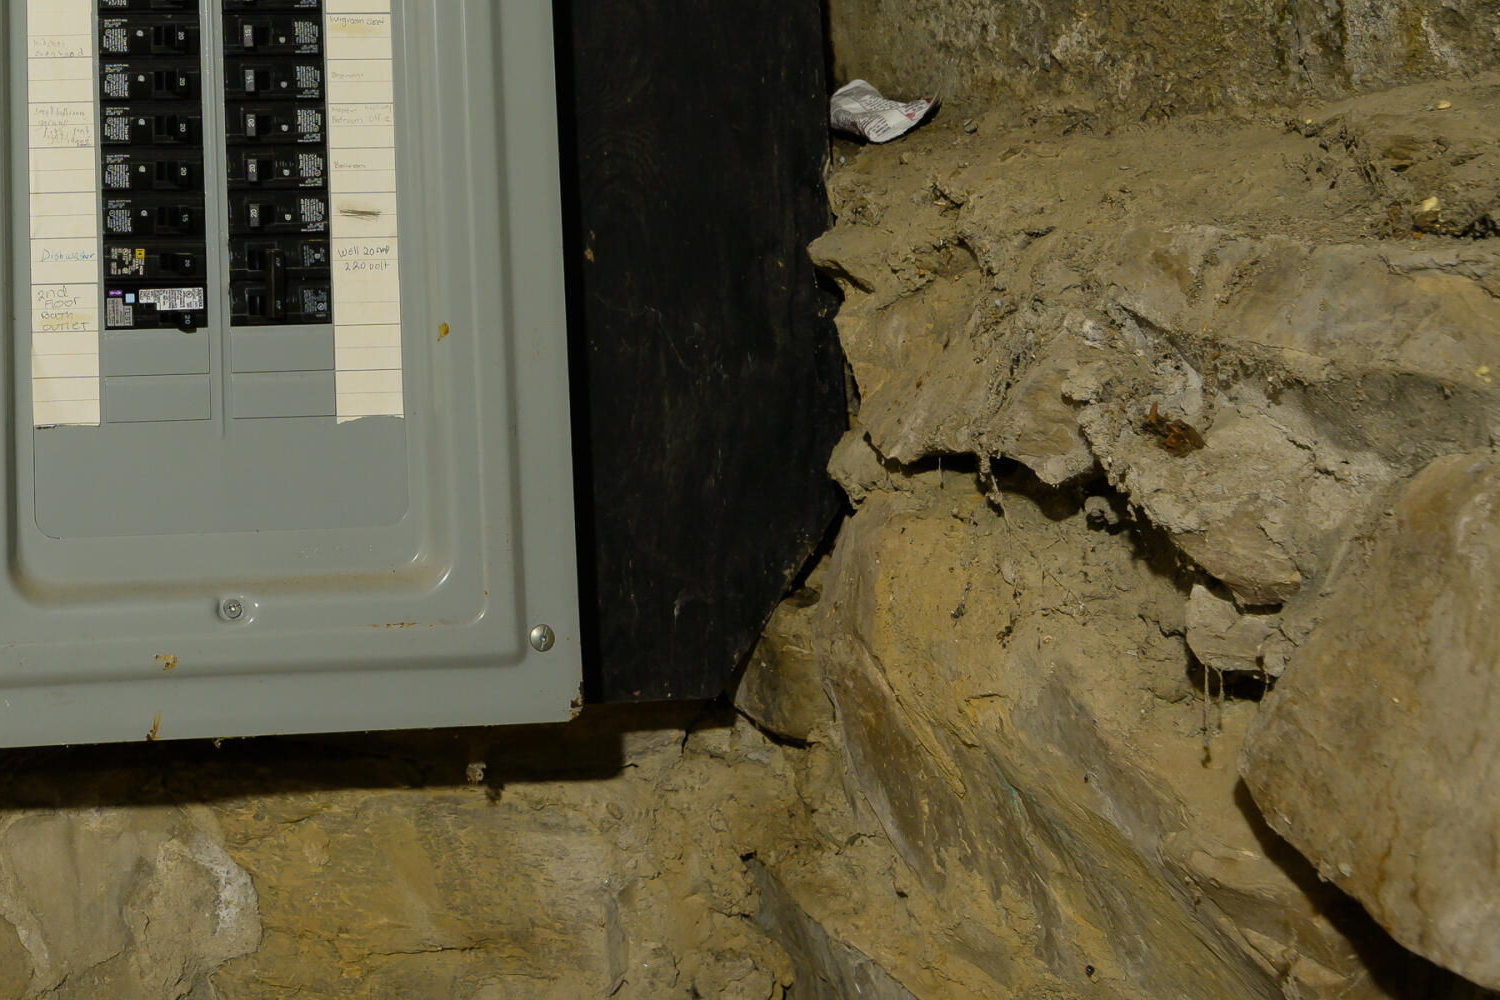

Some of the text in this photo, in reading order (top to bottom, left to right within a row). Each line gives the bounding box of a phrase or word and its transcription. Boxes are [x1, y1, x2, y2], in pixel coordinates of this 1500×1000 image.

[245, 29, 251, 37] 15
[180, 123, 186, 132] 20
[247, 119, 254, 127] 20
[181, 167, 186, 176] 20
[249, 164, 255, 172] 20
[250, 209, 257, 217] 20
[363, 247, 375, 256] 20
[345, 262, 366, 271] 220
[185, 314, 191, 325] 20
